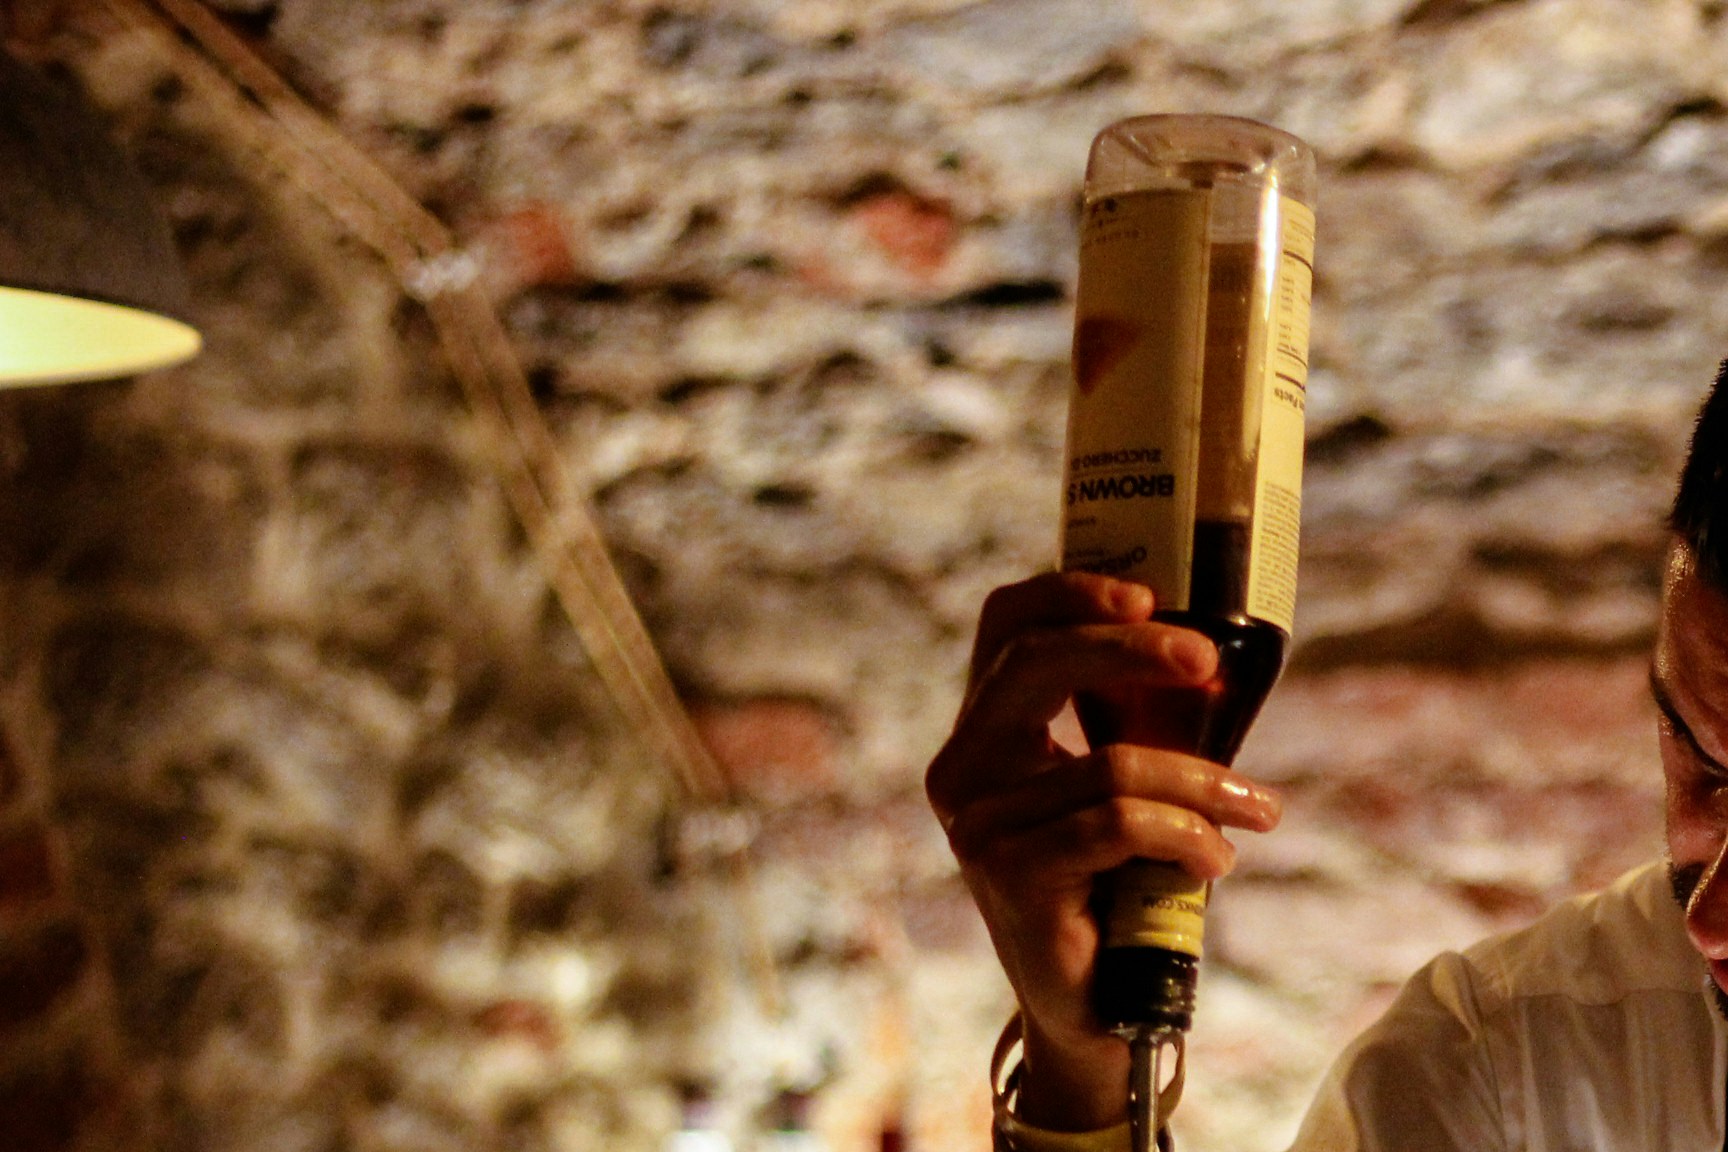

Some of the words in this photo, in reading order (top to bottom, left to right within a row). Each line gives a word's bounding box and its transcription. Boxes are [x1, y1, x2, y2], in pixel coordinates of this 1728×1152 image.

[1275, 388, 1298, 408] Facts
[1082, 448, 1161, 468] ZUCCHERO
[1080, 474, 1174, 501] BROWN
